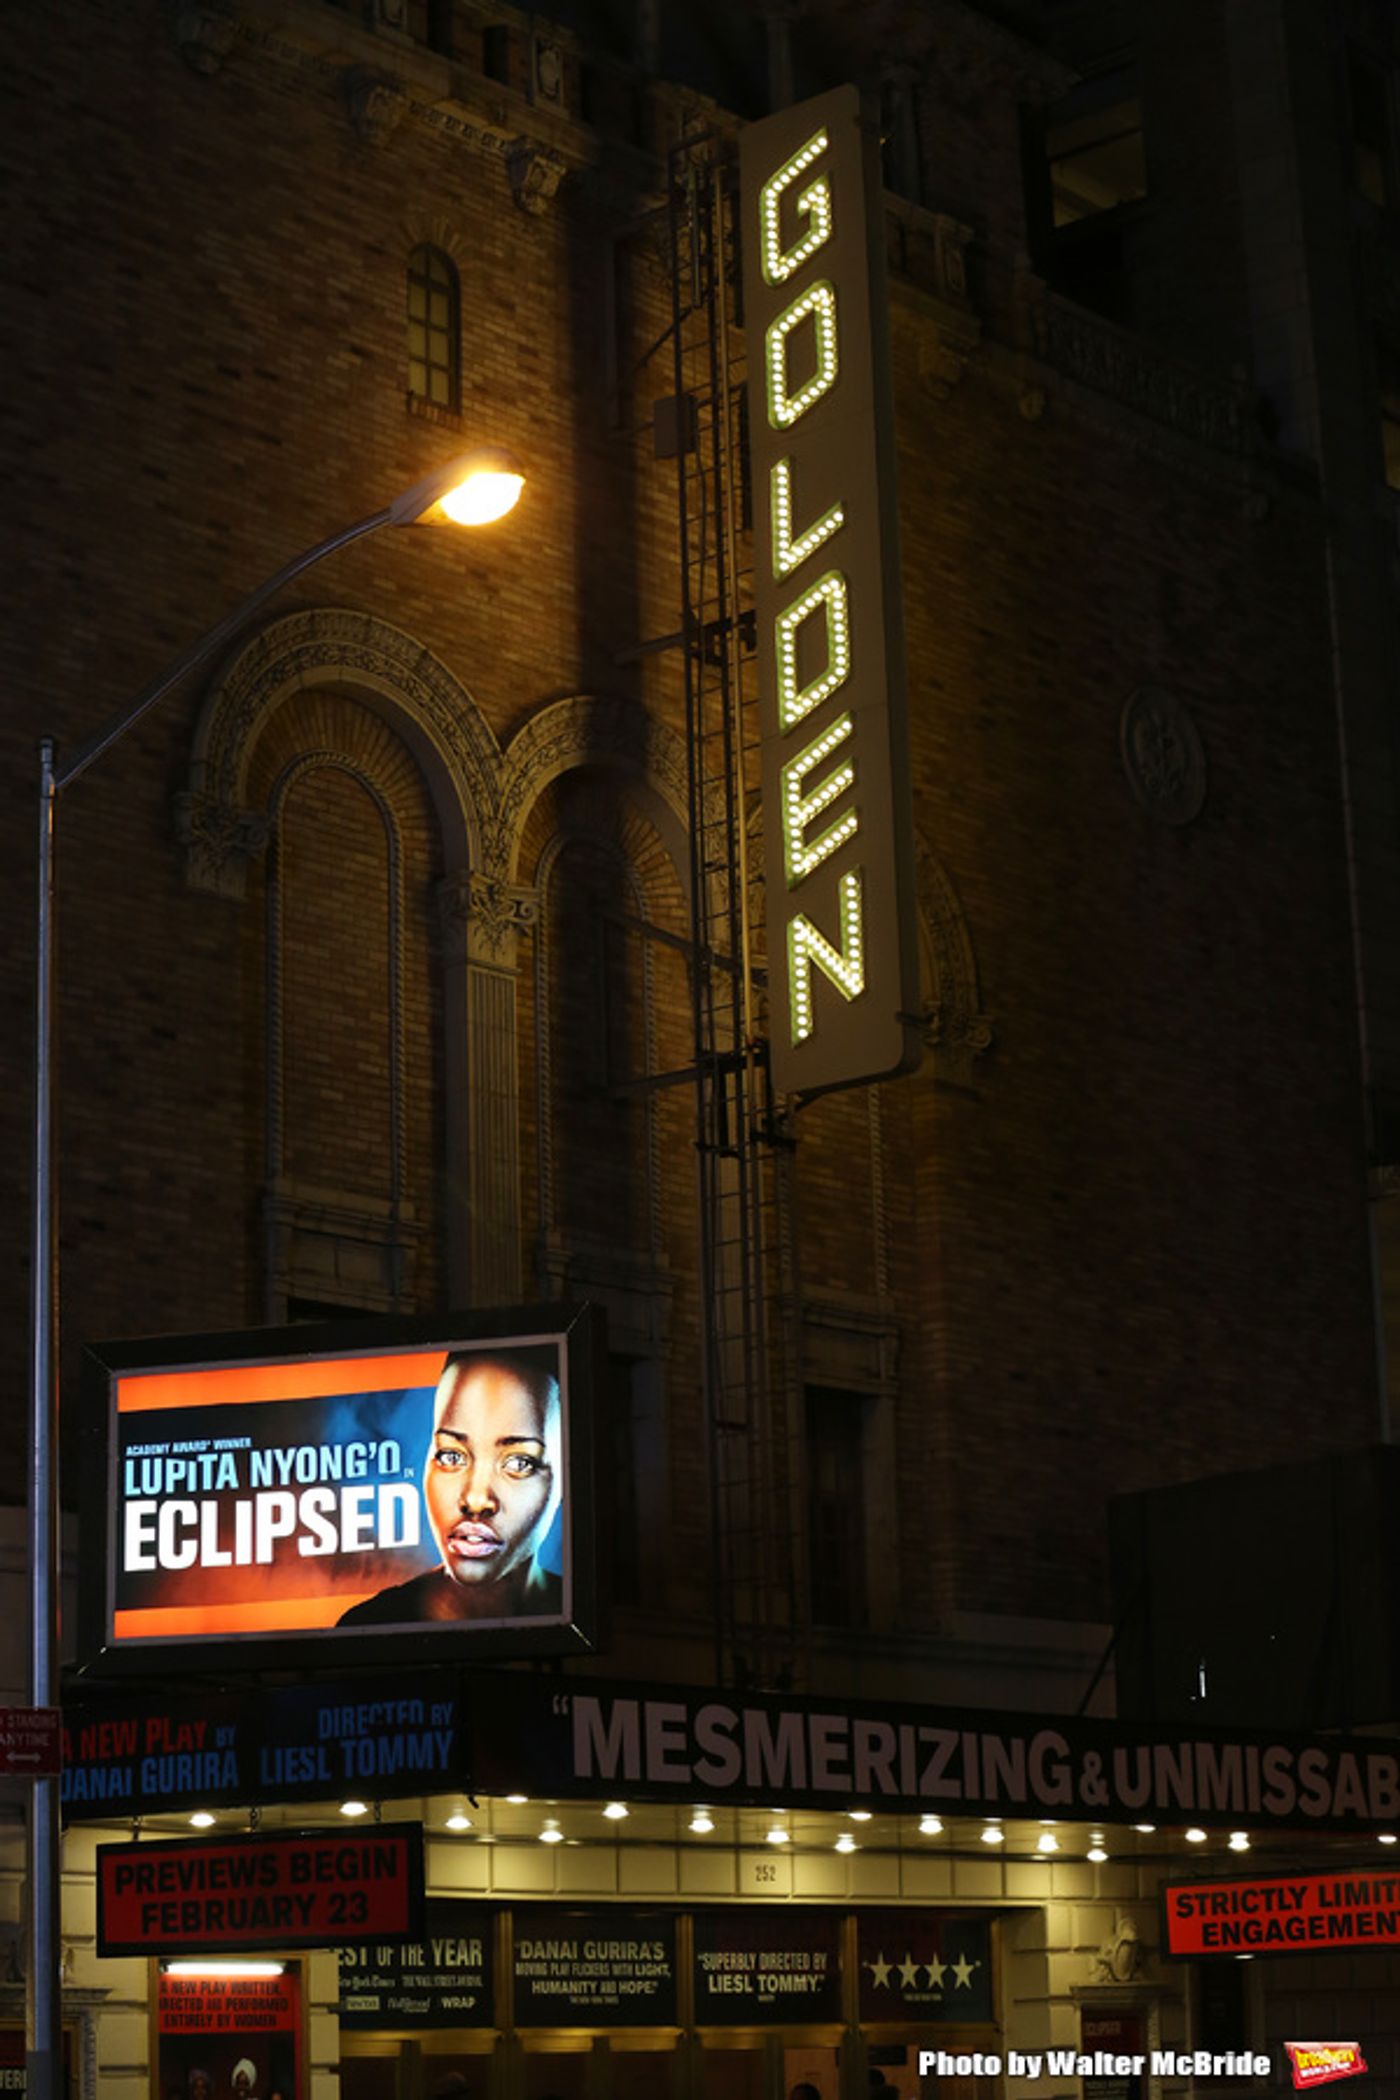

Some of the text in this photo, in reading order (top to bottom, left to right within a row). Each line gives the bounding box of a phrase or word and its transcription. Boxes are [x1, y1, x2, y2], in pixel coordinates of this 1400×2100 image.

[760, 126, 864, 1048] GOLDEN
[125, 1452, 239, 1496] LUPITA
[251, 1440, 400, 1488] NYONG'O
[124, 1483, 420, 1572] ECLIPSED
[79, 1718, 139, 1761] NEW
[145, 1714, 209, 1755] PLAY
[215, 1724, 237, 1748] BY
[317, 1698, 456, 1740] DIRECTED BY
[140, 1750, 241, 1796] GURIRA
[259, 1729, 455, 1788] LIESL TOMMY
[115, 1845, 397, 1895] PREVIEWS BEGIN
[755, 1865, 777, 1882] 252
[141, 1892, 369, 1934] FEBRUARY 23
[1176, 1886, 1308, 1919] STRICTLY
[431, 1938, 483, 1967] YEAR
[583, 1941, 665, 1960] GURIRA'S
[759, 1952, 811, 1971] DIRECTED
[812, 1952, 828, 1971] BY
[531, 1980, 598, 1995] HUMANITY
[708, 1974, 753, 1993] LIESL
